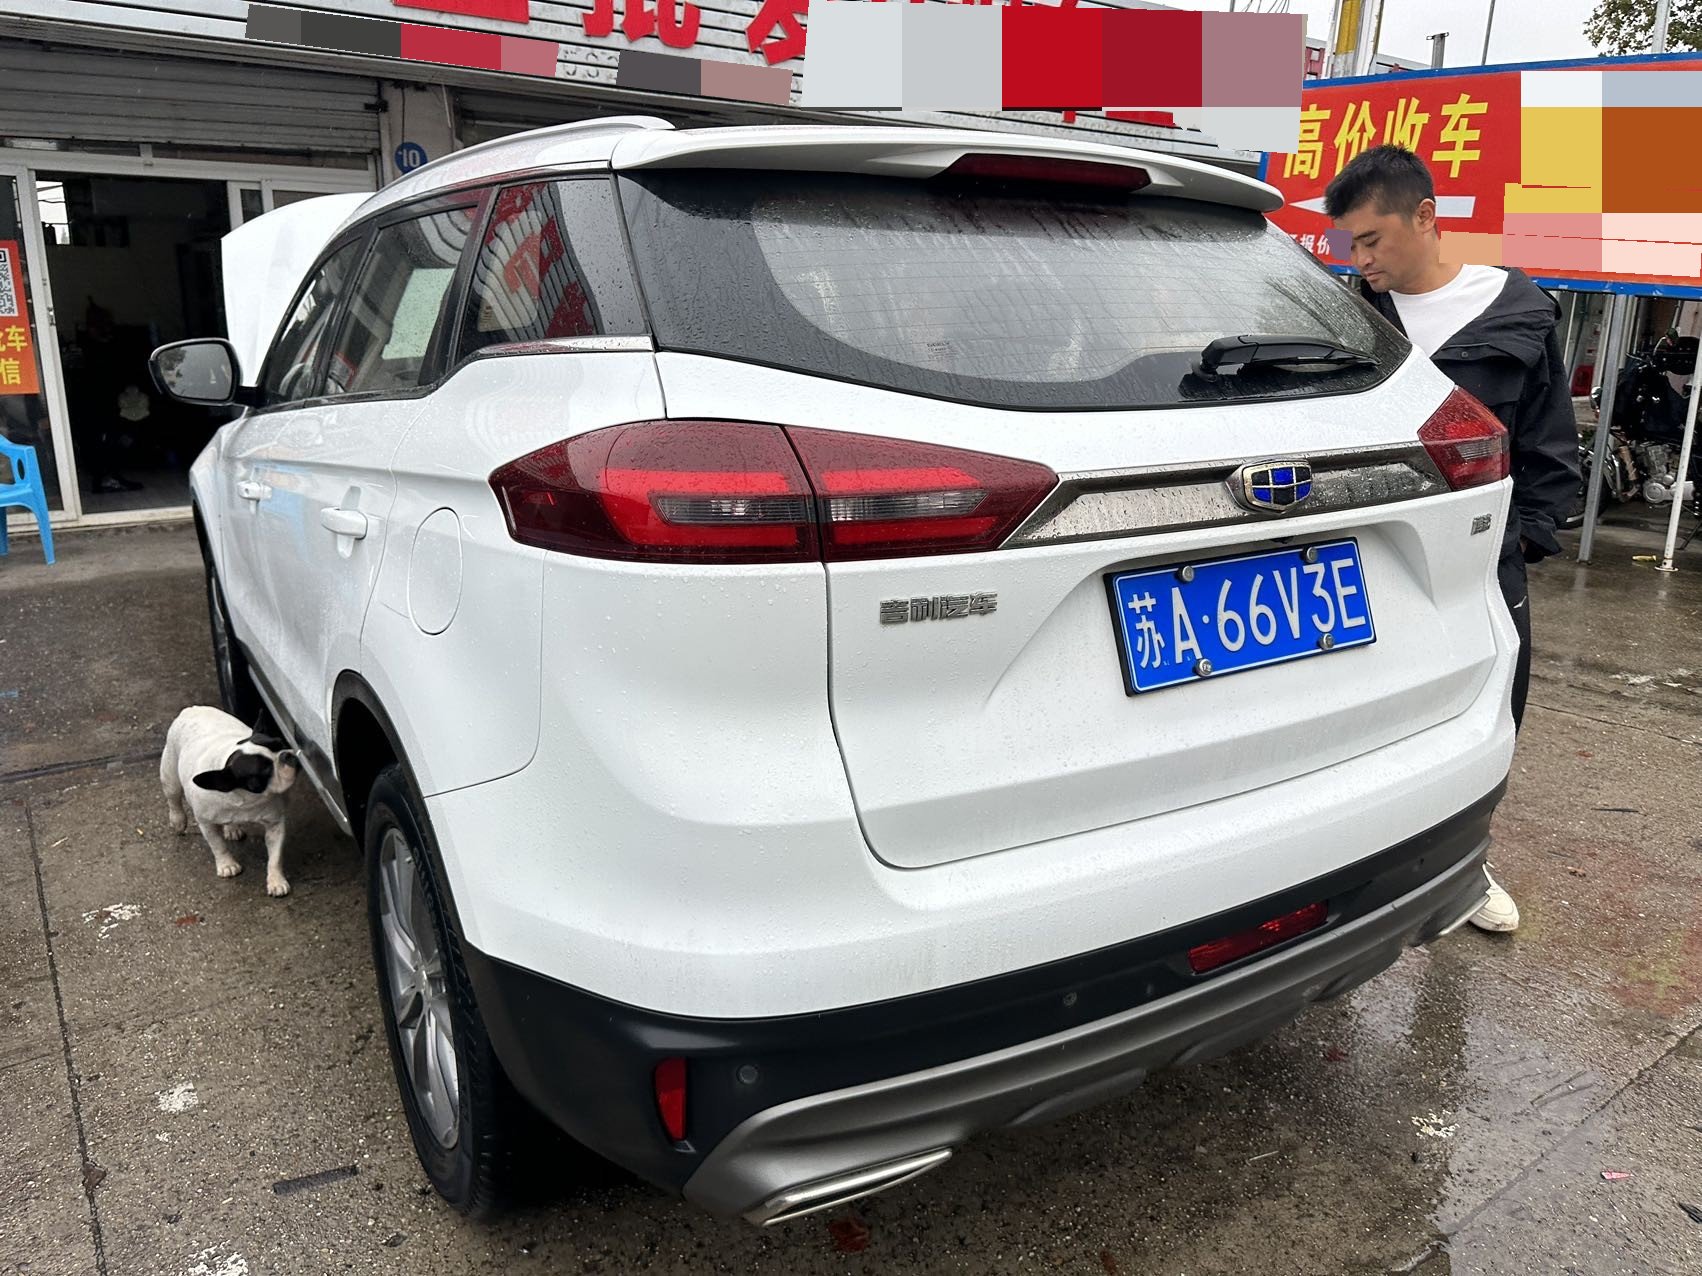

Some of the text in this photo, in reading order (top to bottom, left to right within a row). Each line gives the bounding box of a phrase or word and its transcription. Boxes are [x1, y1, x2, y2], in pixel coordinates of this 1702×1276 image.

[1283, 93, 1488, 179] 高价收车
[403, 149, 420, 167] 10
[0, 325, 28, 352] 车
[880, 592, 998, 625] 吉利汽车
